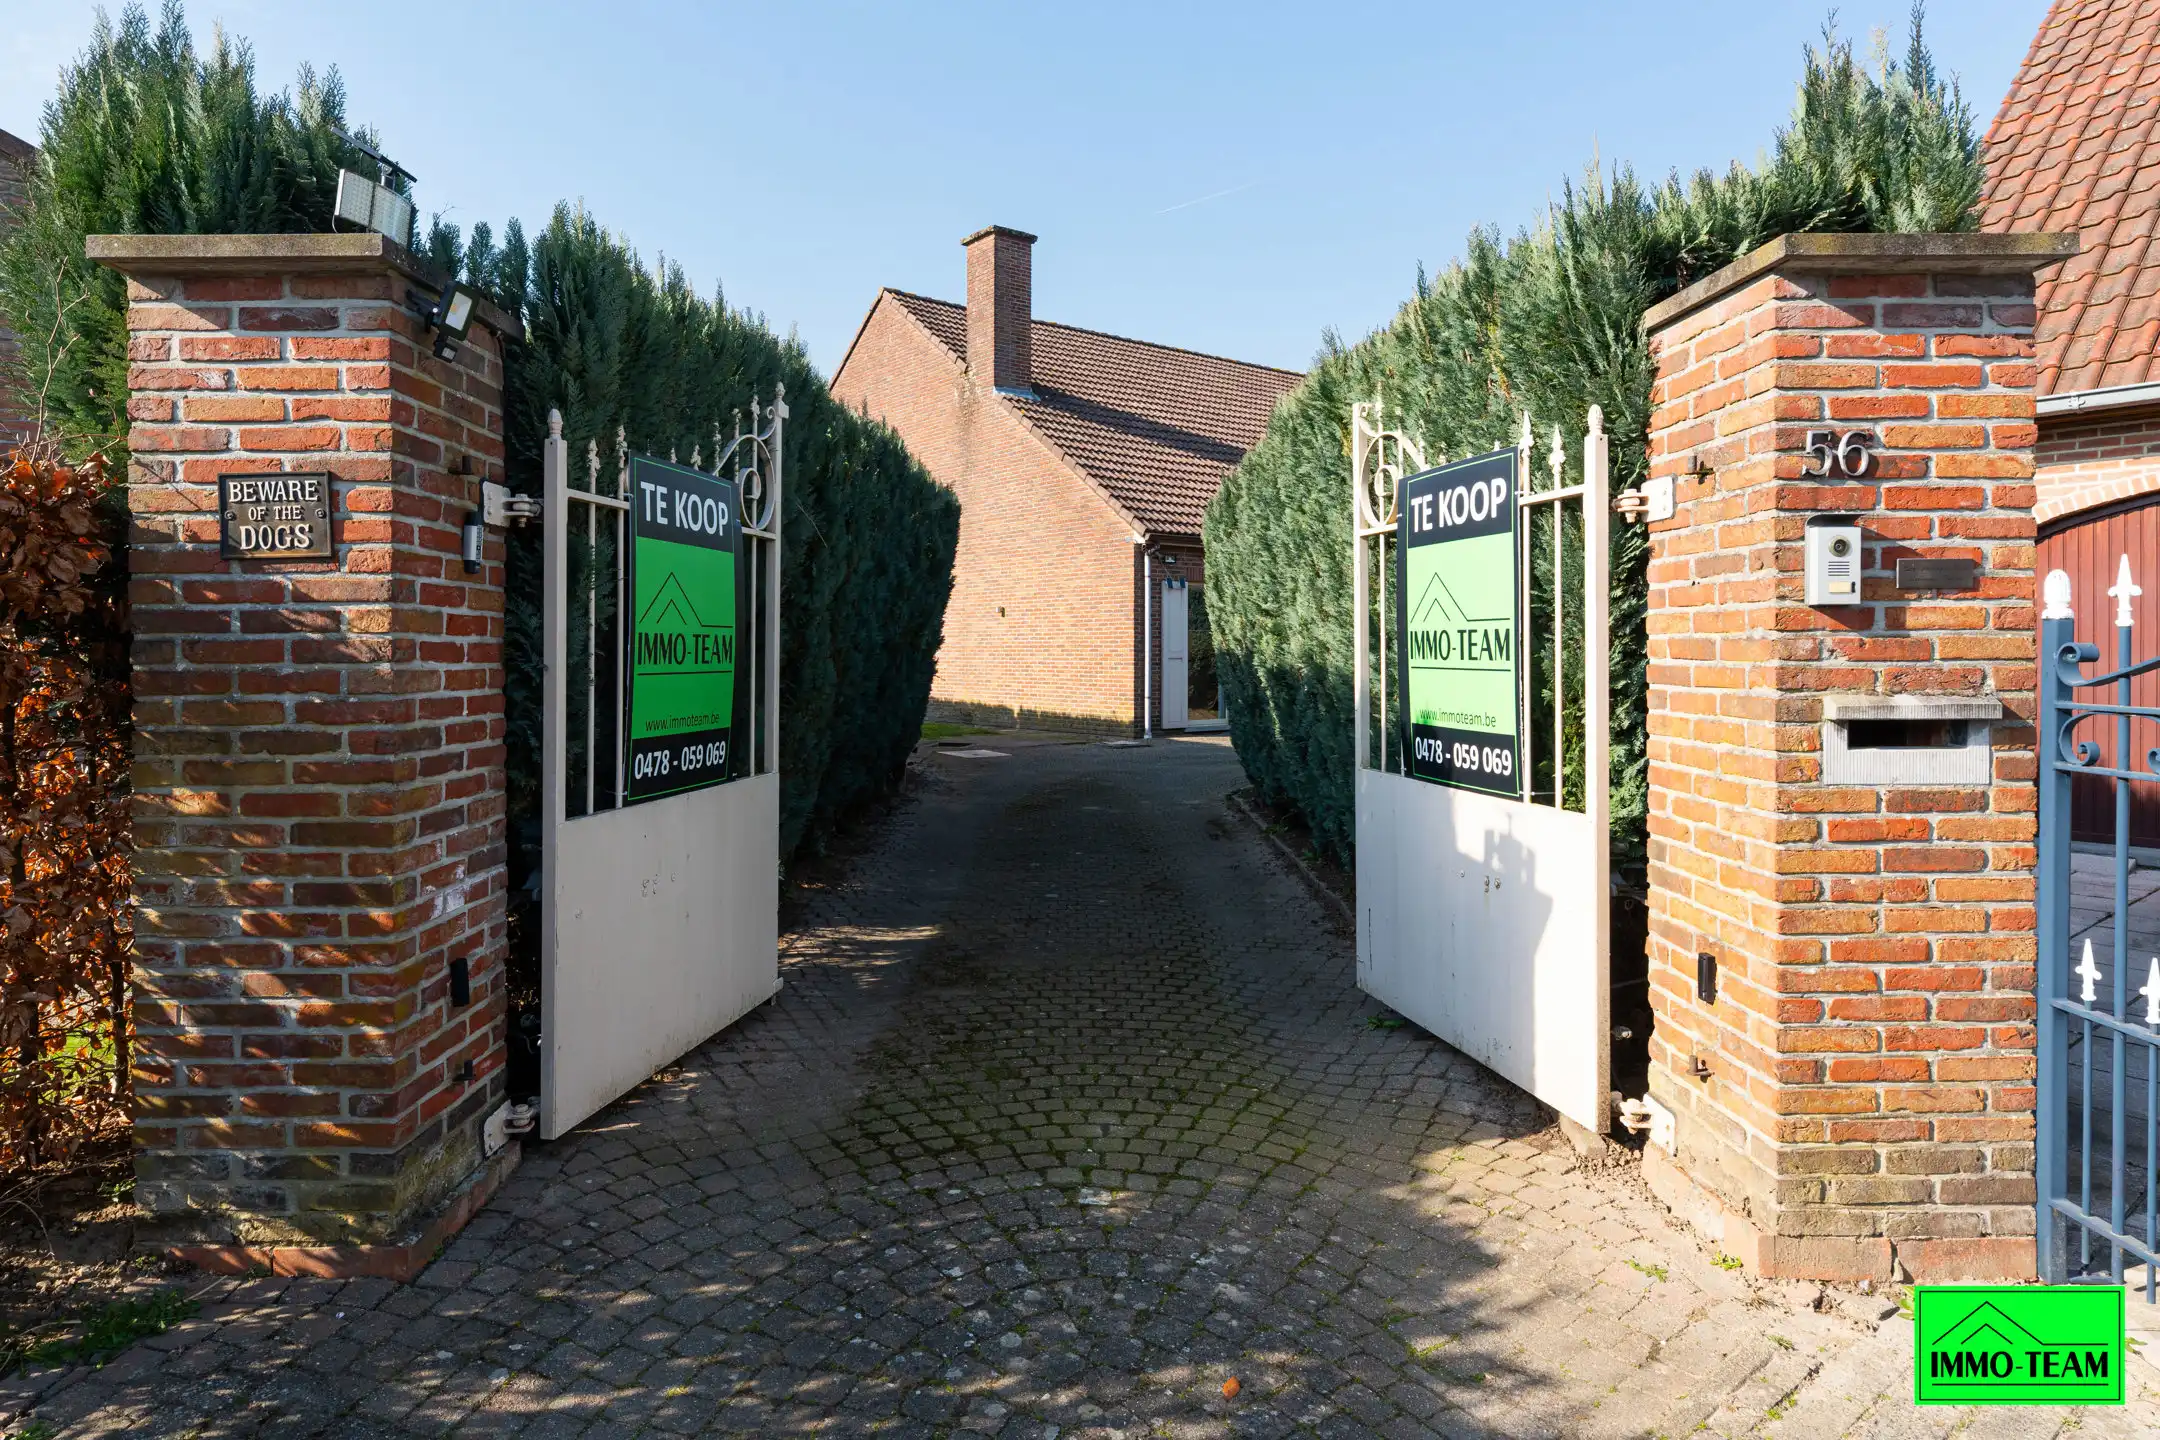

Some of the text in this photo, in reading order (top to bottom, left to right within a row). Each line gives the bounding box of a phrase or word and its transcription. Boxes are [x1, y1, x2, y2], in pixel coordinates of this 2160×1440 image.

[1802, 430, 1870, 477] 56
[228, 480, 319, 503] BEWARE
[640, 480, 729, 537] TE KOOP
[1410, 477, 1507, 533] TE KOOP
[248, 505, 302, 521] OF THE
[239, 523, 311, 550] DOGS
[637, 631, 733, 666] IMMO-TEAM
[1410, 628, 1511, 662] IMMO-TEAM
[645, 711, 721, 732] www.immoteam.be
[1418, 707, 1497, 728] www.immoteam.be
[634, 750, 670, 780] 0478
[681, 744, 704, 772] 059
[706, 740, 727, 767] 069
[1415, 736, 1443, 764] 0478
[1453, 742, 1480, 771] 059
[1482, 746, 1512, 776] 069
